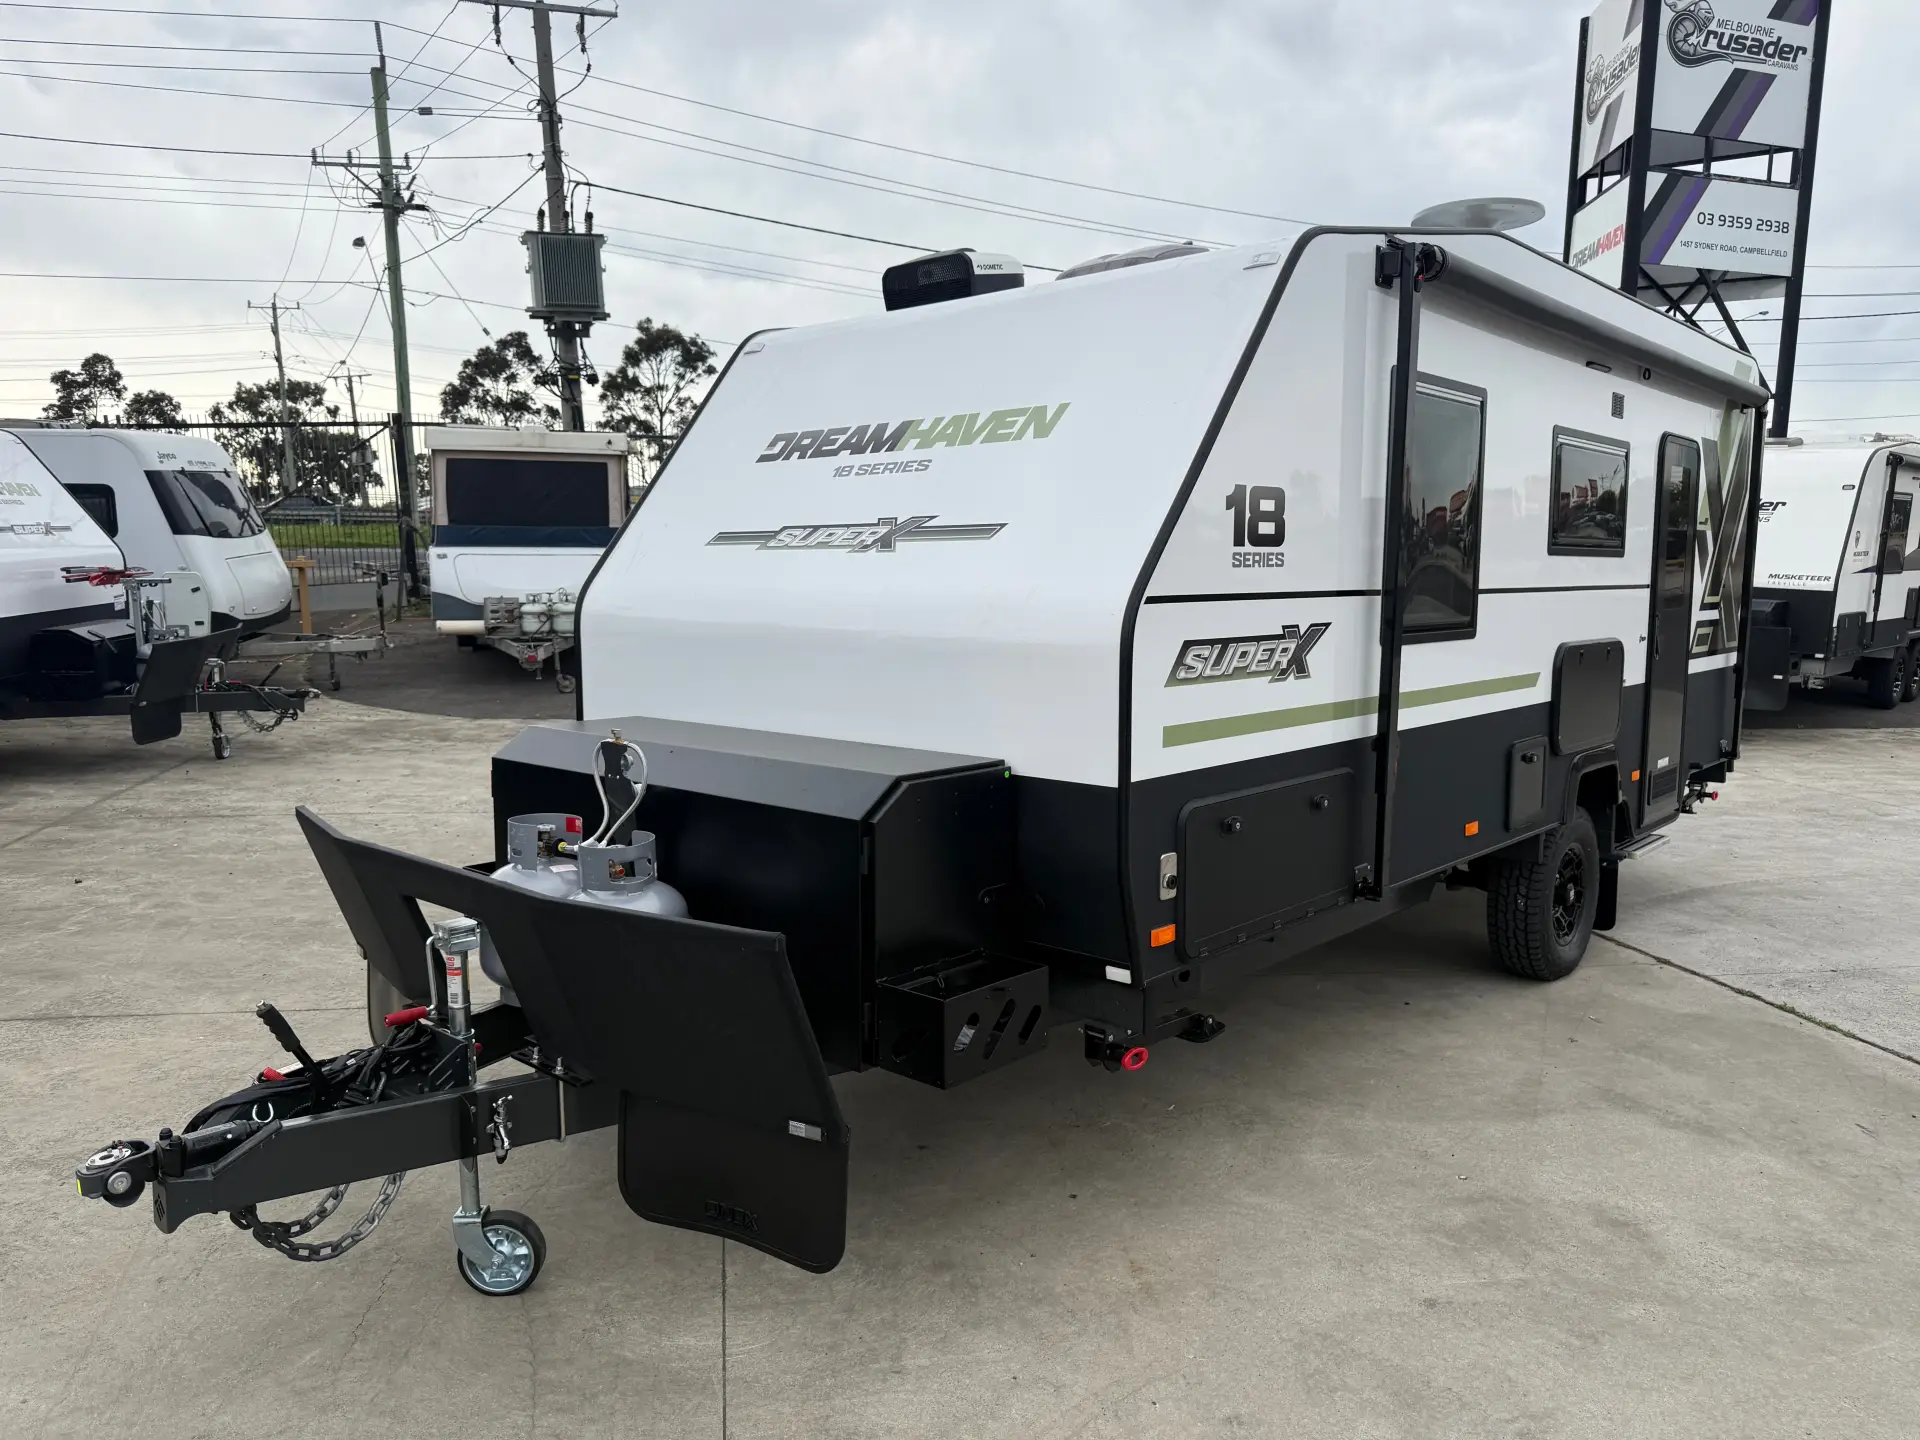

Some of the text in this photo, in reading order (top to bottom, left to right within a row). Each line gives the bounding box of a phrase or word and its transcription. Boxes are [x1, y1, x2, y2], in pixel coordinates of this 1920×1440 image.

[1716, 18, 1776, 39] MELBOURNE
[1767, 59, 1799, 71] CARAVANS
[1697, 212, 1790, 234] 03 9359 2938
[1680, 240, 1788, 258] 1457 SYDNEY ROAD, CAMPBELLFIELD
[832, 458, 933, 478] 18 SERIES
[1225, 483, 1286, 548] 18
[1231, 551, 1285, 568] SERIES
[1767, 573, 1832, 582] MUSKETEER
